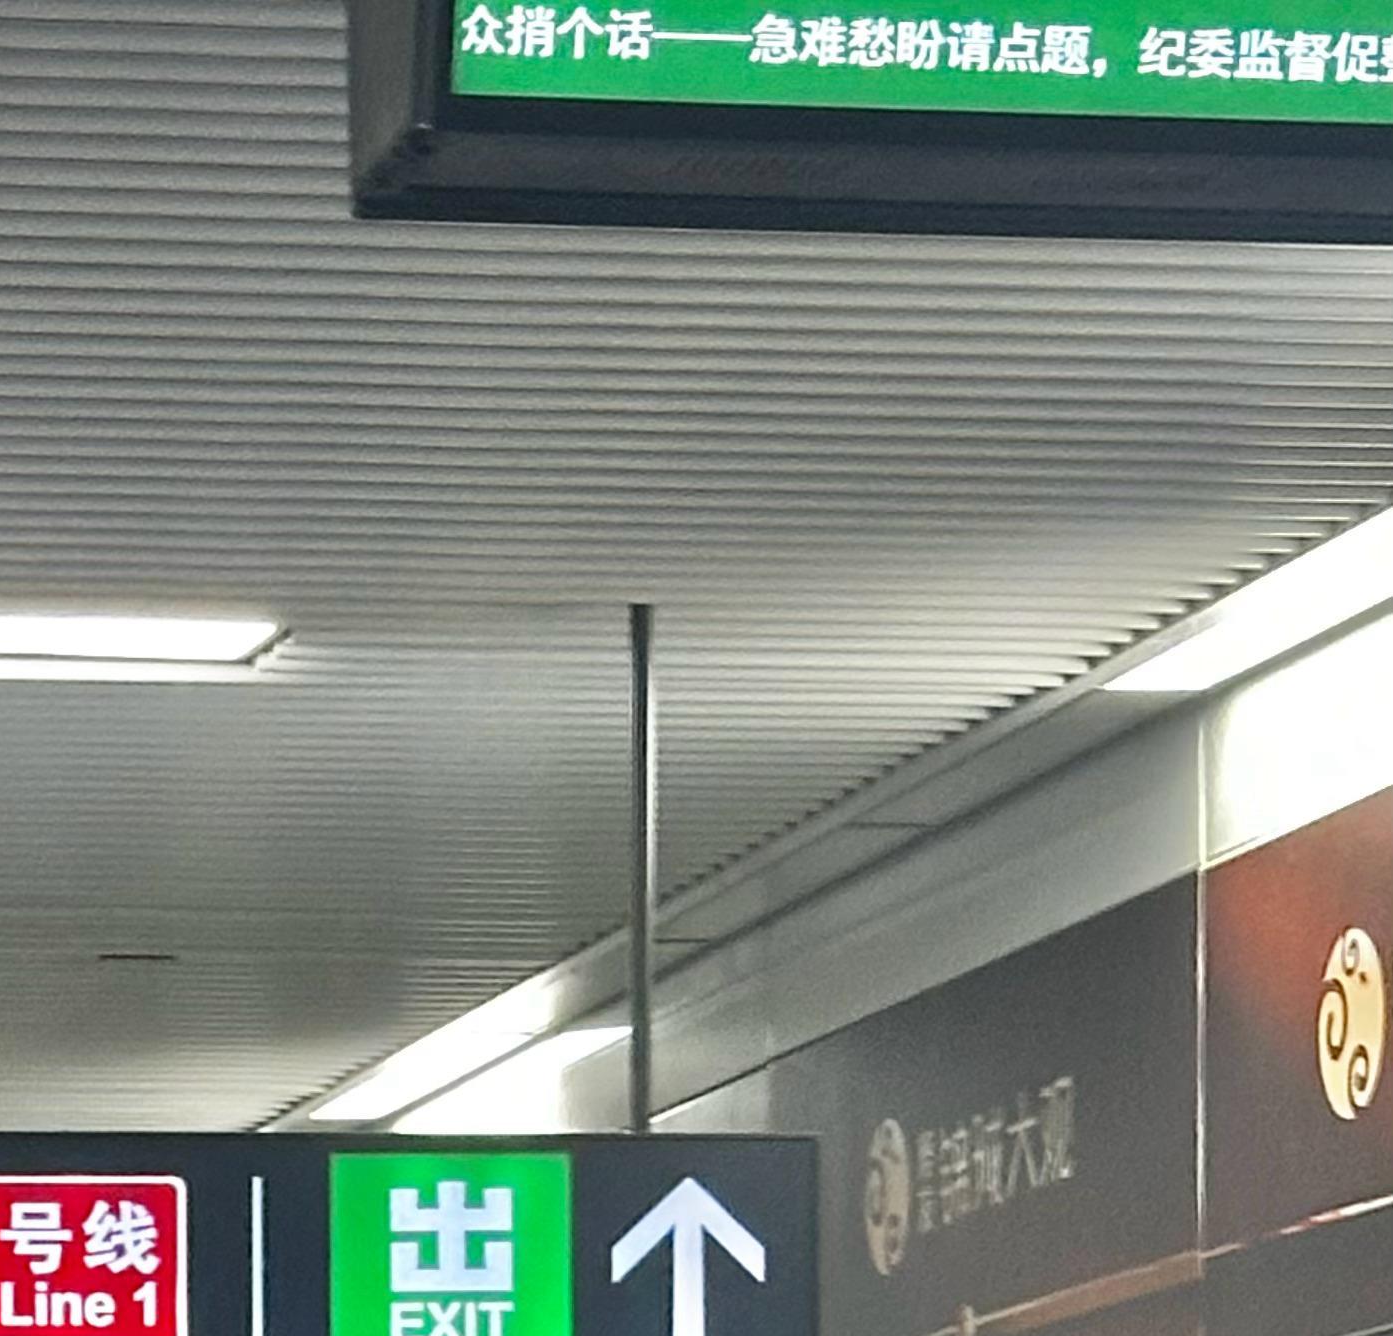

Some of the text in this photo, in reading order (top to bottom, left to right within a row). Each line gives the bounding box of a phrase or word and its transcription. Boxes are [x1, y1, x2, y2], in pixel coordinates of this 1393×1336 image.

[389, 1180, 514, 1292] 出
[0, 1281, 158, 1328] Line 1
